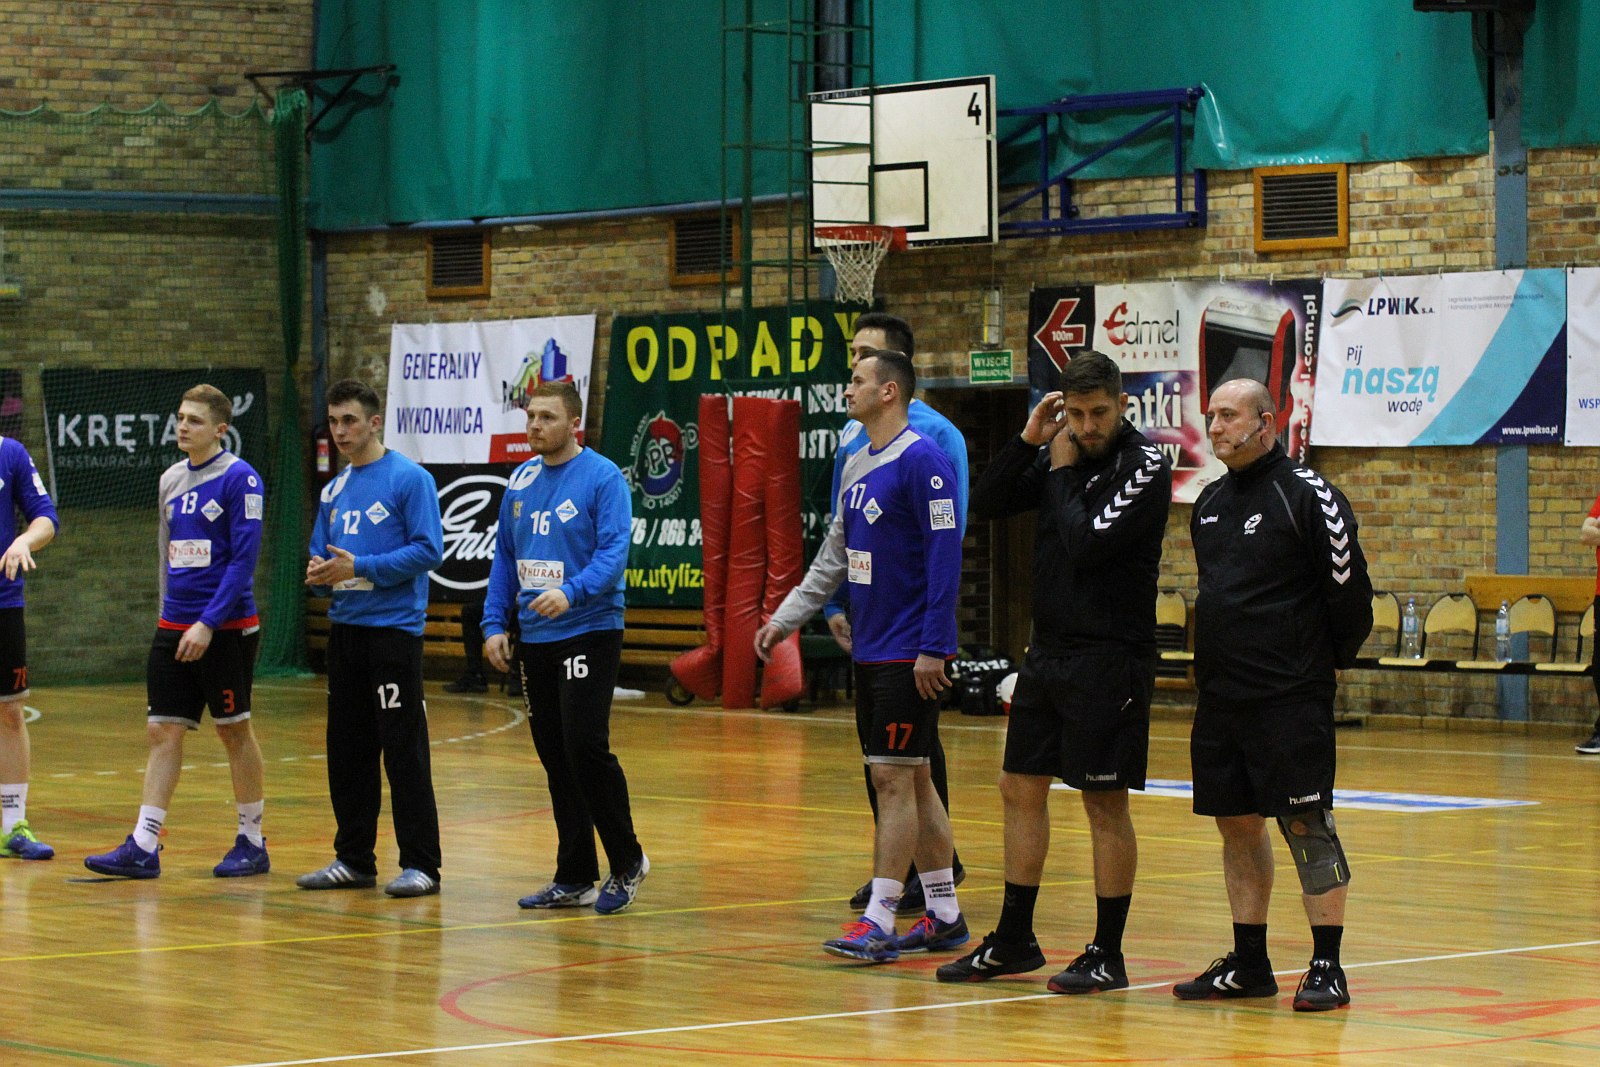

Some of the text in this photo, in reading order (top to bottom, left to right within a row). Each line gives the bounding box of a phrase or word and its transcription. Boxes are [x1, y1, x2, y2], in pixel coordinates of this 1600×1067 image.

[968, 92, 982, 126] 4
[1051, 329, 1075, 343] 100m
[1102, 301, 1180, 346] Edmel
[627, 312, 861, 383] ODPADY
[1121, 350, 1179, 360] PAPIER
[1346, 345, 1363, 366] Pij
[403, 352, 482, 380] GENERALNY
[1341, 365, 1440, 403] naszą
[1387, 396, 1423, 416] wodę
[397, 407, 483, 434] WYKONAWCA
[181, 491, 198, 514] 13
[850, 483, 867, 509] 17
[342, 510, 361, 535] 12
[530, 511, 552, 535] 16
[658, 518, 687, 546] 866
[563, 655, 589, 680] 16
[222, 689, 235, 713] 3
[377, 682, 401, 709] 12
[886, 722, 913, 749] 17
[1086, 772, 1117, 782] hummel
[1289, 791, 1320, 805] hummel
